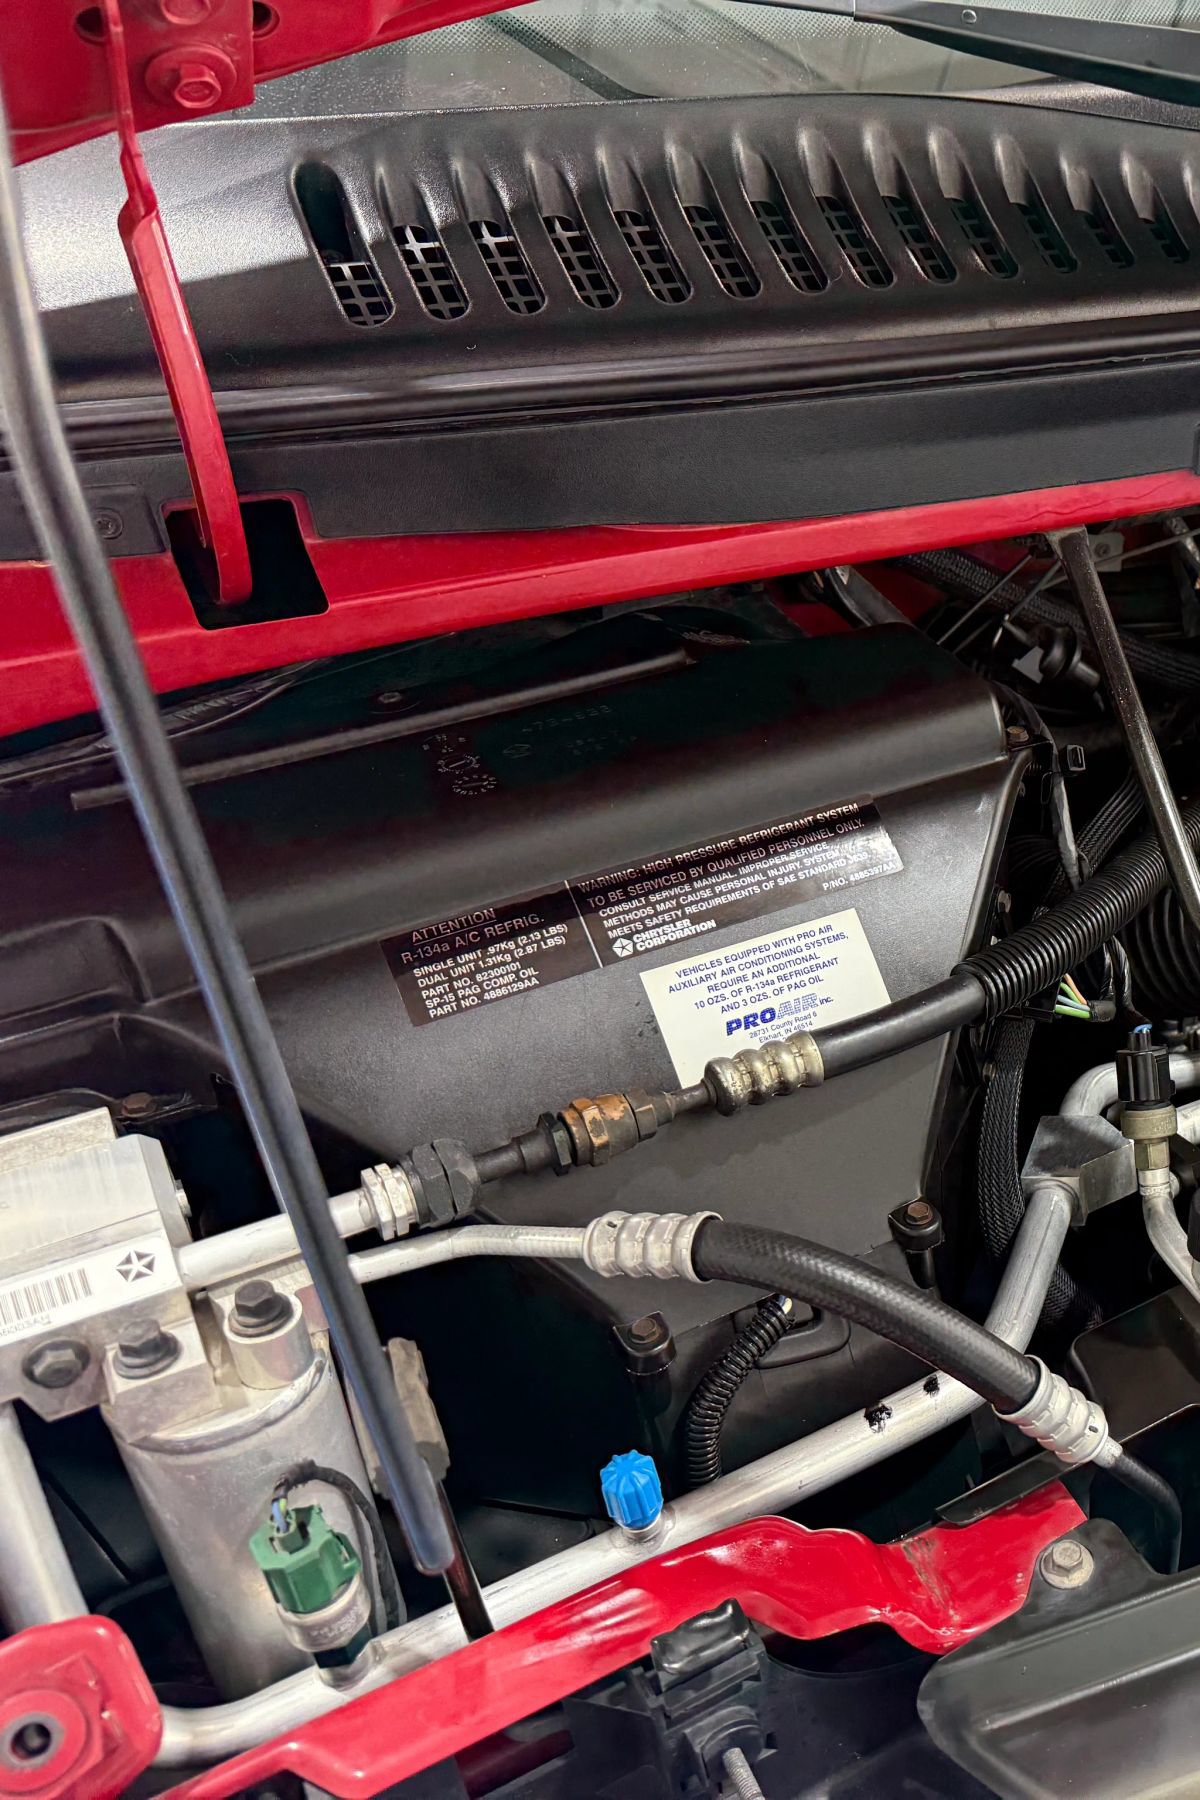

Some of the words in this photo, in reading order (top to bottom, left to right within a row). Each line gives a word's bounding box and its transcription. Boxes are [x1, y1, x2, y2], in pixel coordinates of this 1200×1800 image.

[577, 868, 641, 894] WARNING:
[642, 857, 673, 876] HIGH
[675, 838, 738, 865] PRESSURE
[738, 815, 815, 847] REFRIGERANT
[816, 802, 860, 823] SYSTEM
[585, 894, 606, 909] TO
[607, 888, 626, 902] BE
[628, 871, 687, 897] SERVICED
[689, 865, 704, 878] BY
[707, 847, 766, 873] QUALIFIED
[768, 828, 835, 855] PERSONNEL
[835, 818, 865, 835] ONLY.
[599, 896, 646, 917] CONSULT
[648, 883, 692, 902] SERVICE
[694, 871, 737, 889] MANUAL.
[738, 853, 790, 875] IMPROPER
[789, 841, 829, 860] SERVICE
[603, 906, 655, 928] METHODS
[656, 898, 678, 912] MAY
[679, 888, 714, 905] CAUSE
[715, 873, 767, 895] PERSONAL
[767, 861, 802, 878] INJURY.
[803, 850, 841, 867] SYSTEM
[607, 922, 644, 939] MEETS
[645, 910, 683, 928] SAFETY
[685, 884, 761, 916] REQUIREMENTS
[762, 880, 775, 891] OF
[778, 874, 797, 887] SAE
[799, 858, 847, 880] STANDARD
[822, 876, 848, 891] P/NO.
[401, 942, 450, 965] R-134a
[455, 931, 481, 949] A/C
[484, 913, 545, 939] REFRIG.
[412, 907, 497, 944] ATTENTION
[633, 918, 693, 943] CHRYSLER
[636, 919, 717, 952] CORPORATION
[413, 959, 456, 978] SINGLE
[457, 950, 483, 965] UNIT
[486, 940, 516, 956] .97Kg
[517, 931, 542, 947] (2.13
[544, 923, 568, 937] LBS)
[417, 972, 449, 988] DUAL
[451, 963, 476, 979] UNIT
[478, 953, 512, 969] 1.31Kg
[513, 945, 538, 961] (2.87
[541, 936, 567, 950] LBS)
[668, 972, 717, 994] AUXILIARY
[721, 966, 736, 979] AIR
[739, 942, 803, 972] CONDITIONING
[804, 931, 849, 951] SYSTEMS,
[675, 958, 722, 979] VEHICLES
[724, 943, 771, 964] EQUIPPED
[772, 935, 796, 949] WITH
[797, 929, 816, 942] PRO
[818, 924, 833, 936] AIR
[421, 984, 450, 1000] PART
[453, 976, 474, 991] NO.
[476, 961, 522, 983] 82300101
[425, 994, 456, 1009] SP-15
[457, 985, 481, 999] PAG
[483, 975, 518, 991] COMP.
[519, 966, 539, 980] OIL
[694, 1000, 706, 1010] 10
[707, 993, 730, 1007] OZS.
[731, 987, 744, 998] OF
[745, 978, 775, 994] R-134a
[777, 957, 839, 984] REFRIGERANT
[707, 974, 750, 994] REQUIRE
[751, 970, 765, 981] AN
[766, 952, 821, 975] ADDITIONAL
[721, 1000, 741, 1015] AND
[742, 998, 748, 1007] 3
[749, 992, 772, 1005] OZS.
[773, 985, 787, 997] OF
[787, 980, 807, 992] PAG
[808, 973, 824, 985] OIL
[428, 1003, 458, 1019] PART
[460, 995, 482, 1009] NO.
[483, 976, 540, 1001] 4886129AA
[820, 996, 834, 1005] inc.
[749, 1027, 769, 1039] 28731
[770, 1020, 794, 1033] County
[795, 1012, 811, 1023] Road
[759, 1031, 784, 1044] Elkhart,
[785, 1027, 792, 1035] IN
